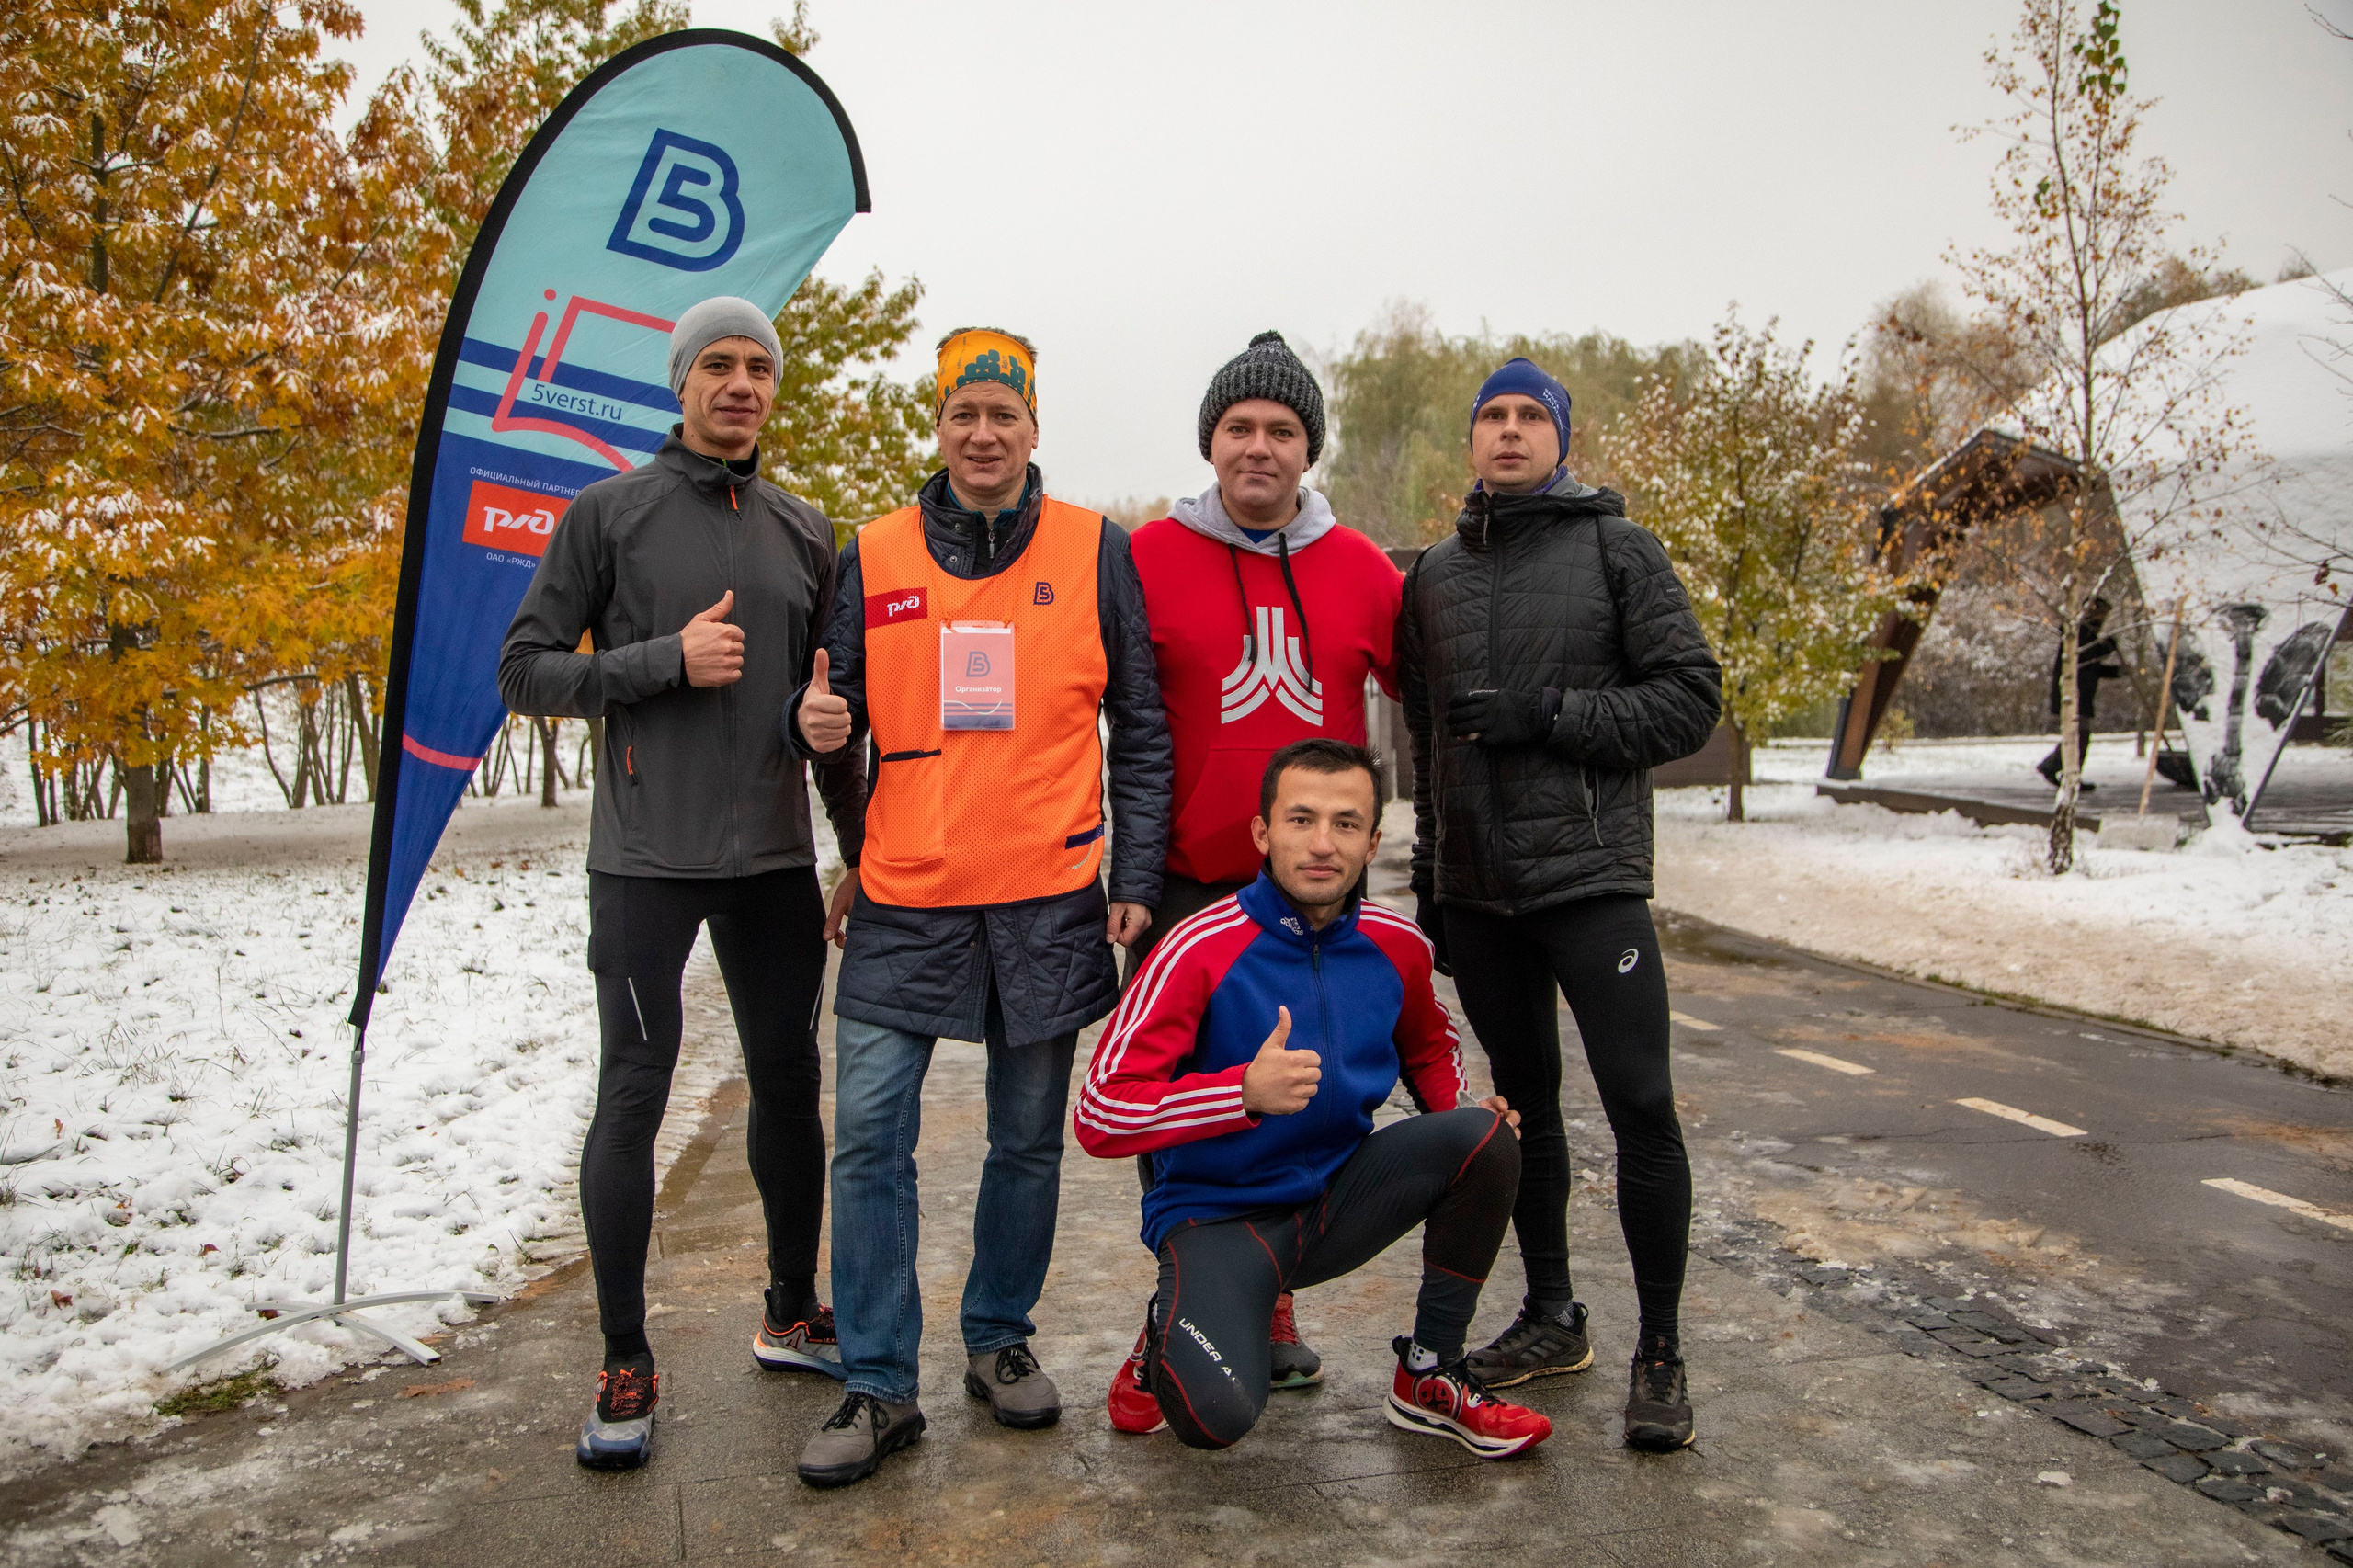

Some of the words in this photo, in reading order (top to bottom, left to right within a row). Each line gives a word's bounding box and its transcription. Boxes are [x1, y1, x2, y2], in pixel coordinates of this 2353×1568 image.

[531, 383, 622, 421] 5verst.ru
[470, 466, 540, 489] ОФИЦИАЛЬНЫЙ
[486, 552, 505, 562] ОАО
[955, 686, 1002, 694] Организатор
[1178, 1317, 1222, 1362] UNDER
